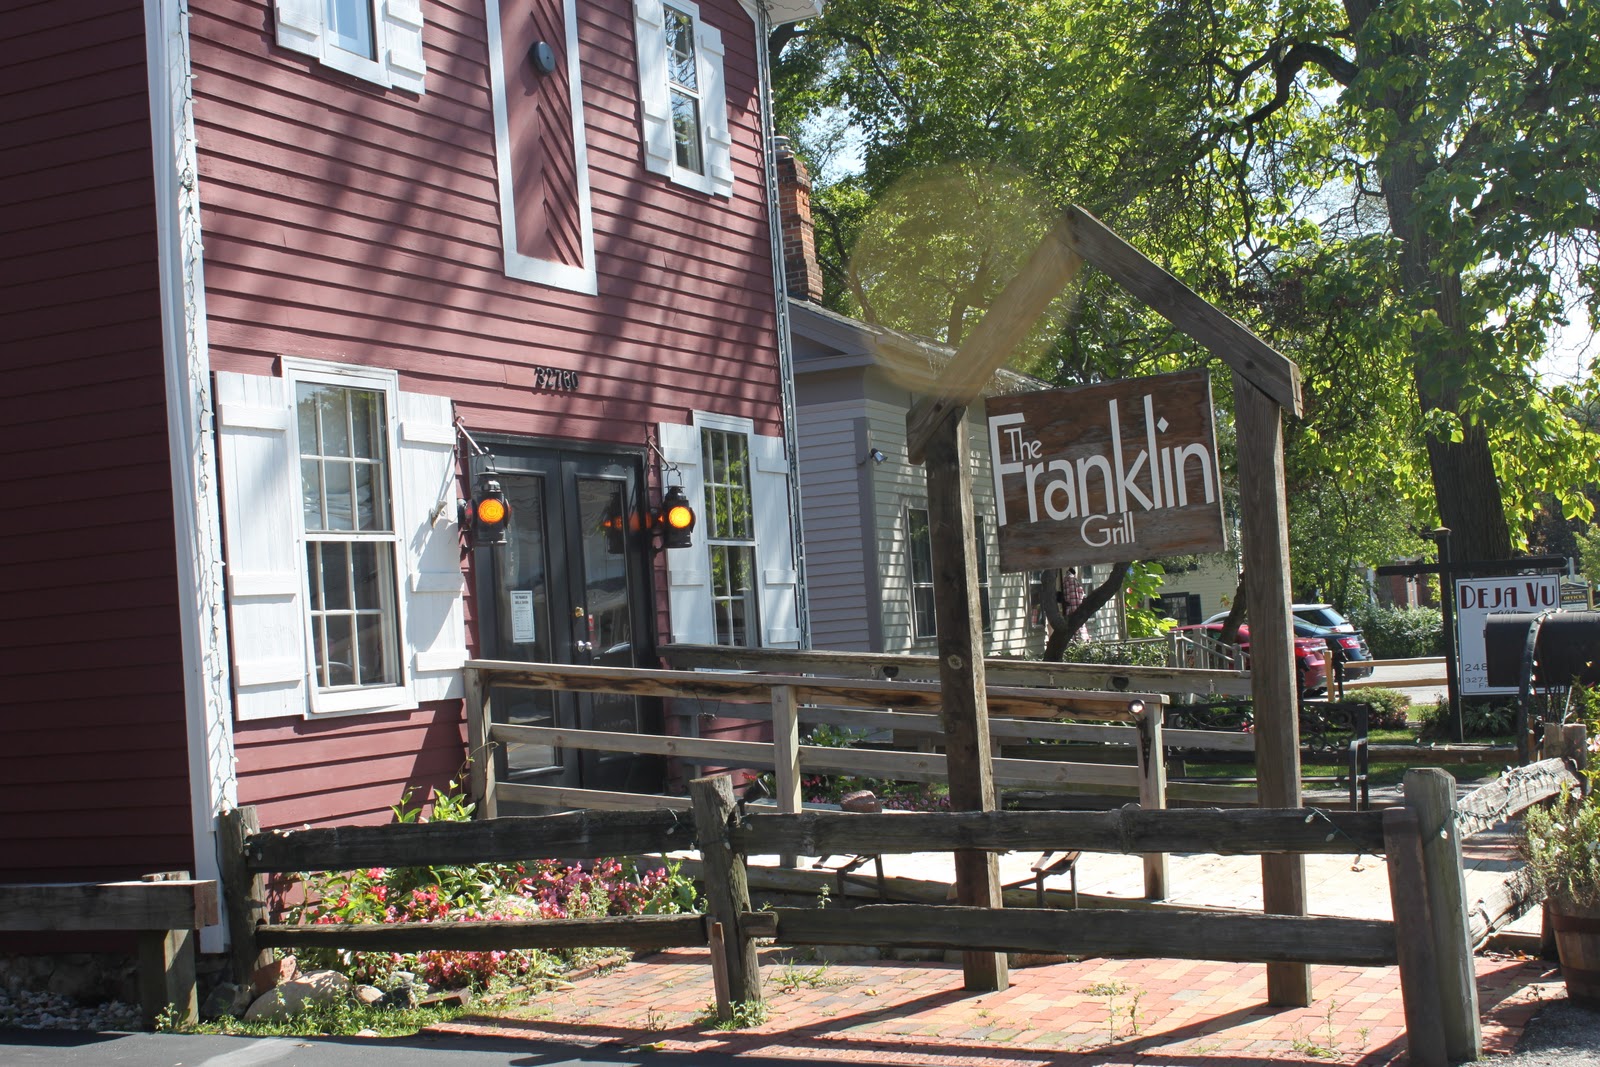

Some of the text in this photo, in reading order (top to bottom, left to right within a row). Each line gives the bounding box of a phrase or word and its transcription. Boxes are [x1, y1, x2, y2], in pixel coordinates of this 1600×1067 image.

[535, 366, 579, 390] 32760
[988, 394, 1215, 527] Franklin
[1004, 427, 1042, 462] The
[1080, 511, 1136, 548] Grill
[1460, 582, 1555, 609] DEJA VU
